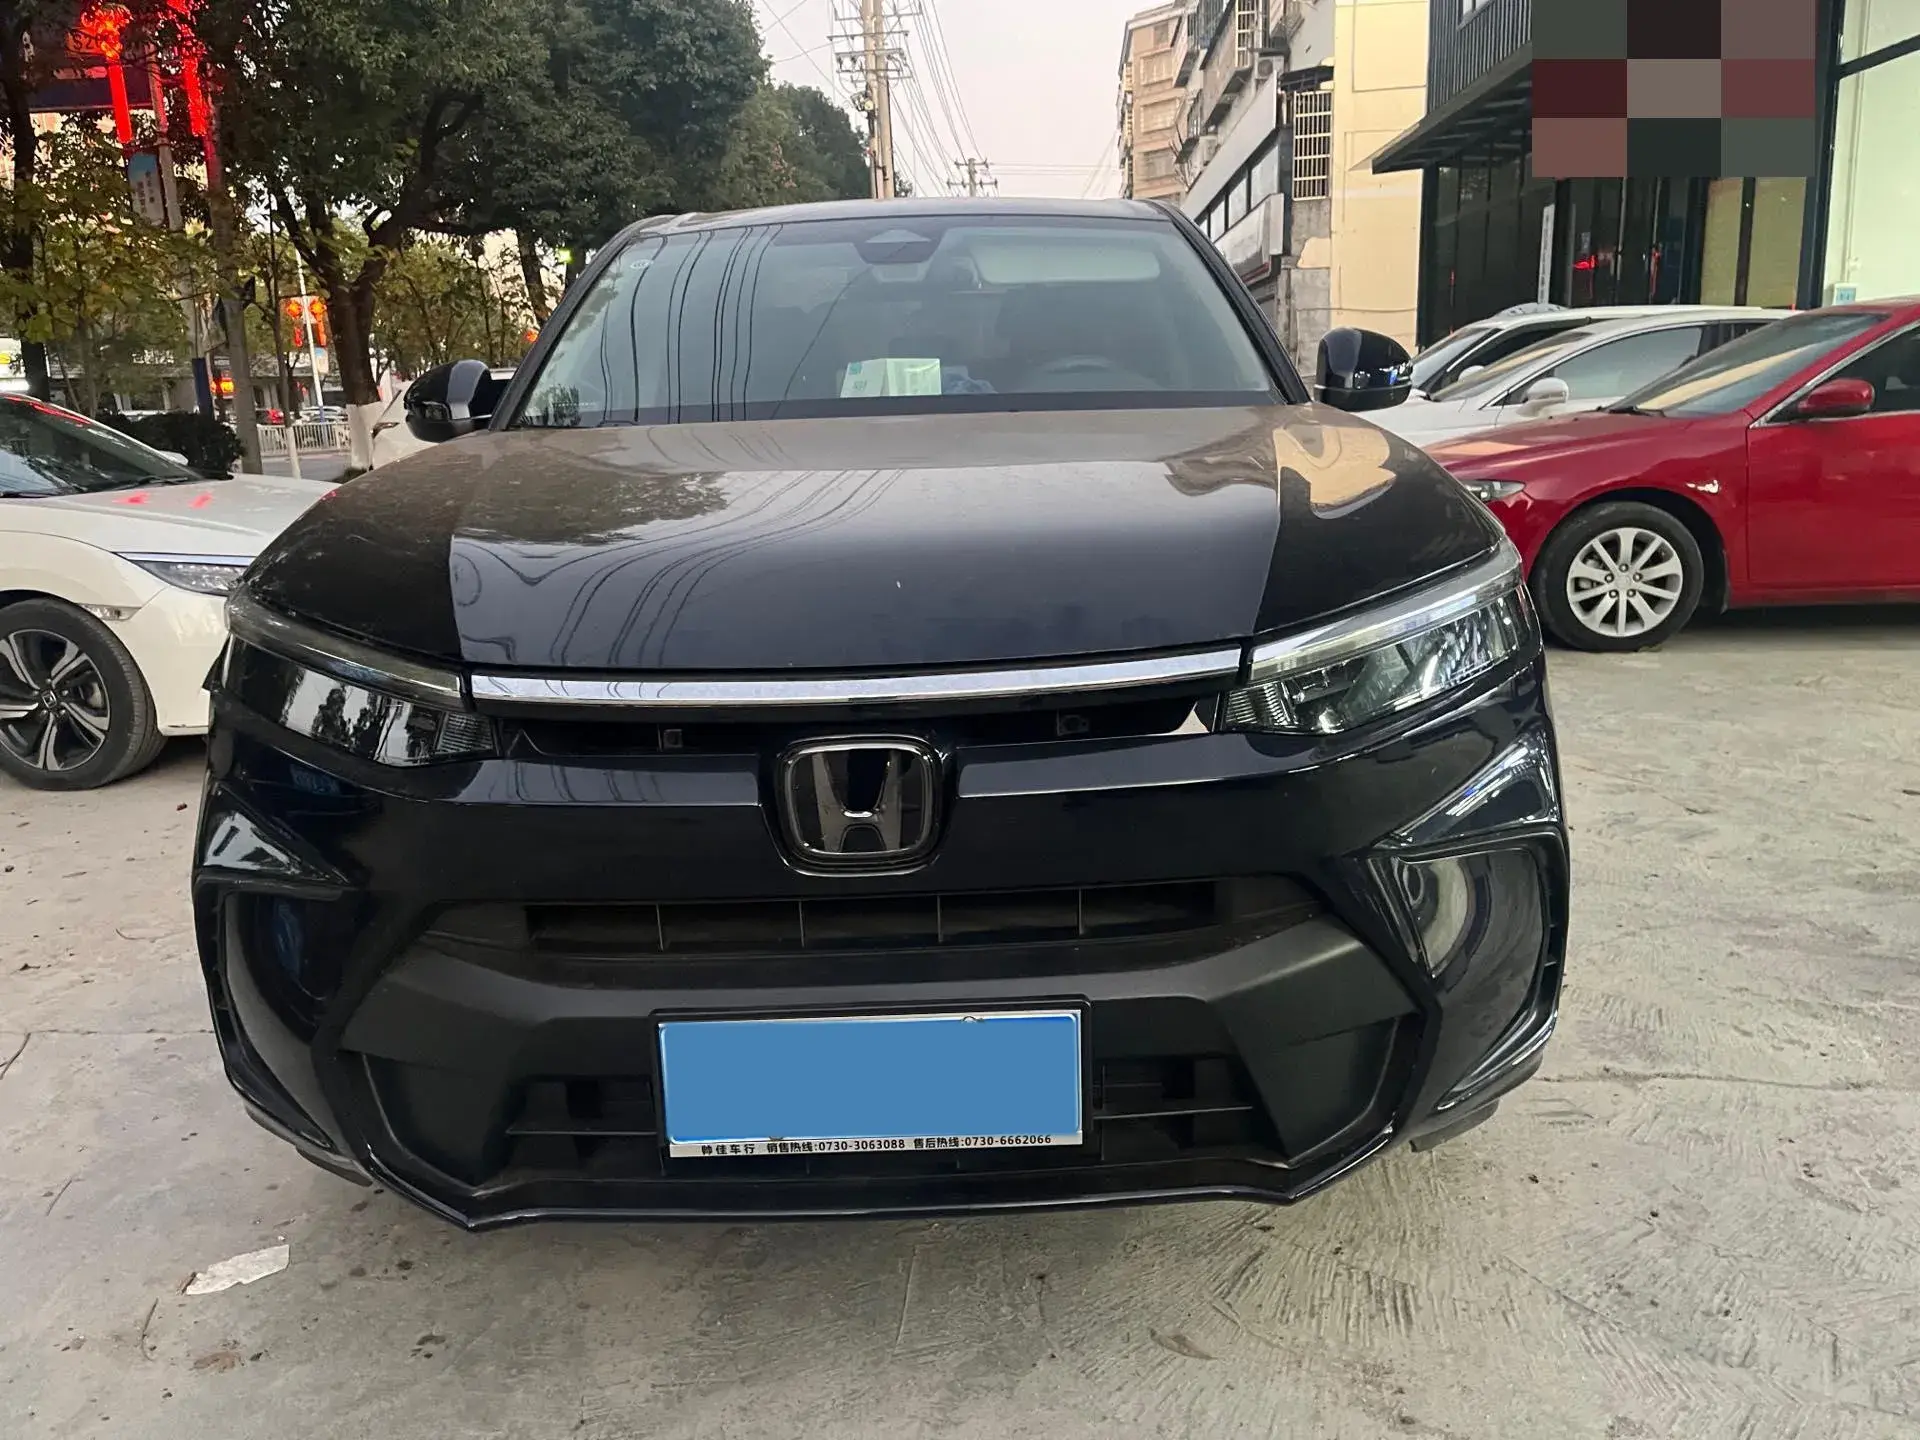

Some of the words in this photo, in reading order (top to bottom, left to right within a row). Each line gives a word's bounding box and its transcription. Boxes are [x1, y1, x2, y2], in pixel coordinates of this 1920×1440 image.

[767, 1140, 905, 1153] 销售热线:0730-3063088
[914, 1135, 1051, 1149] 售后热线:0730-6662066
